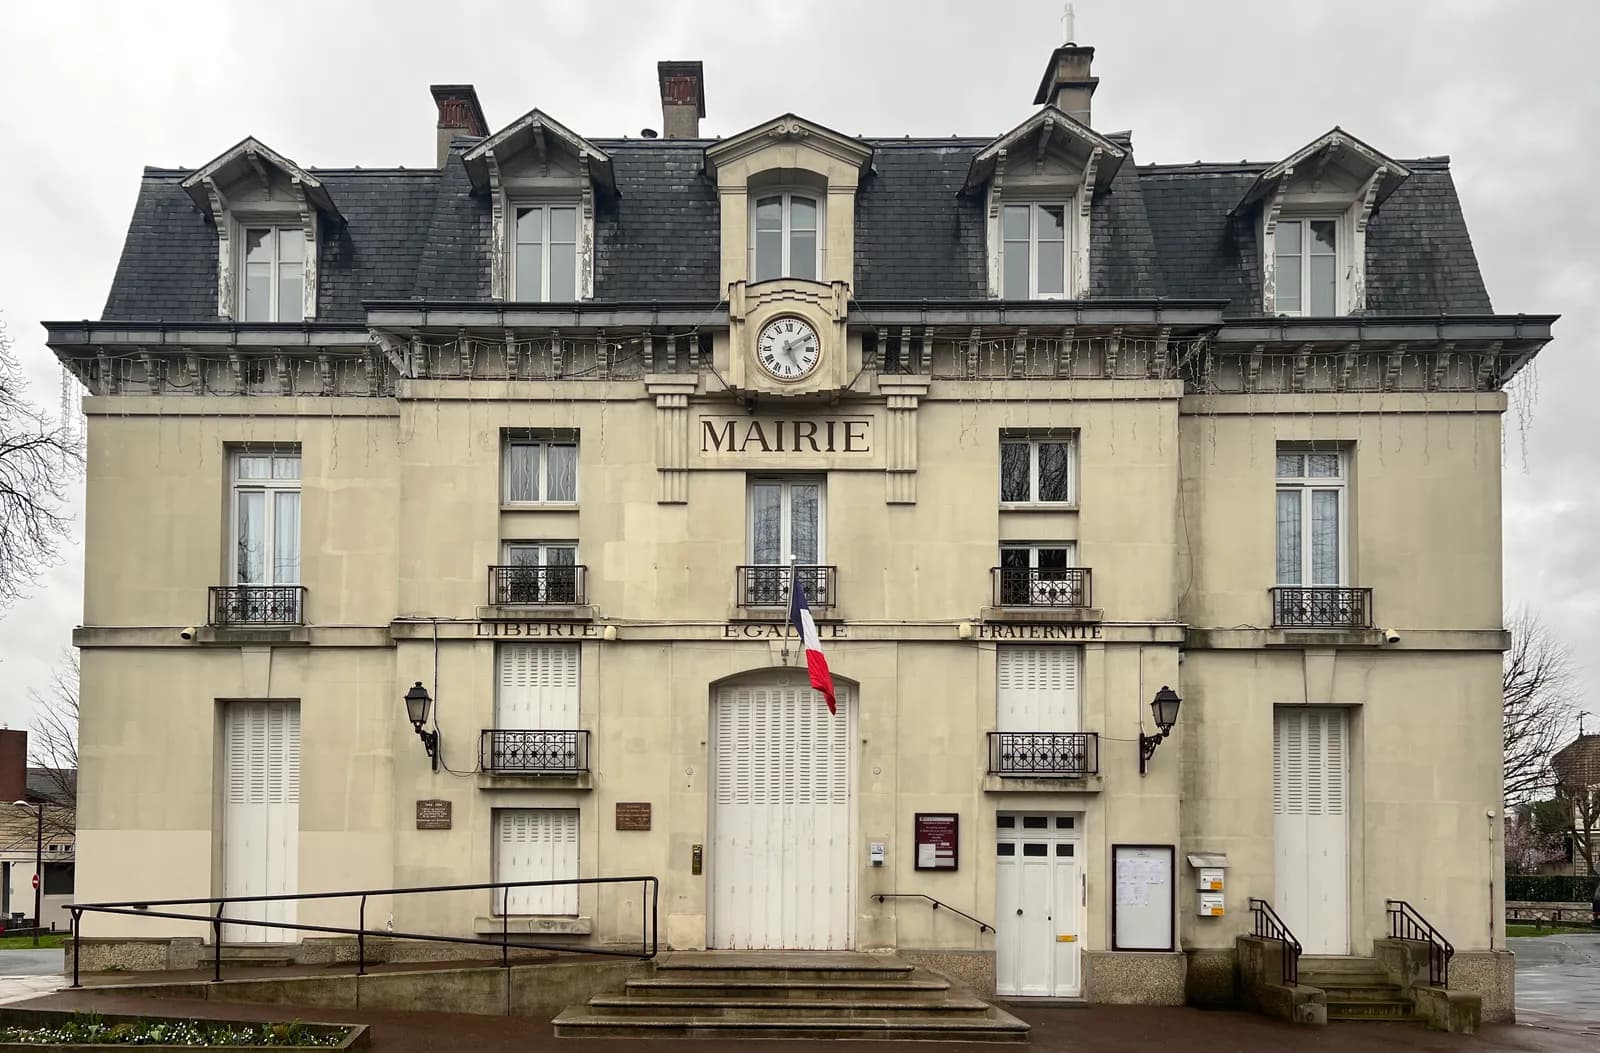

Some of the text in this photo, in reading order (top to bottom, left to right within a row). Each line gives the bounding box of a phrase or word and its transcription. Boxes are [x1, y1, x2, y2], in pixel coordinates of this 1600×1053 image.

[701, 420, 870, 452] MAIRIE
[475, 622, 598, 636] LIBERTE
[723, 624, 849, 638] EGALTE
[979, 625, 1103, 639] FRATERNITE
